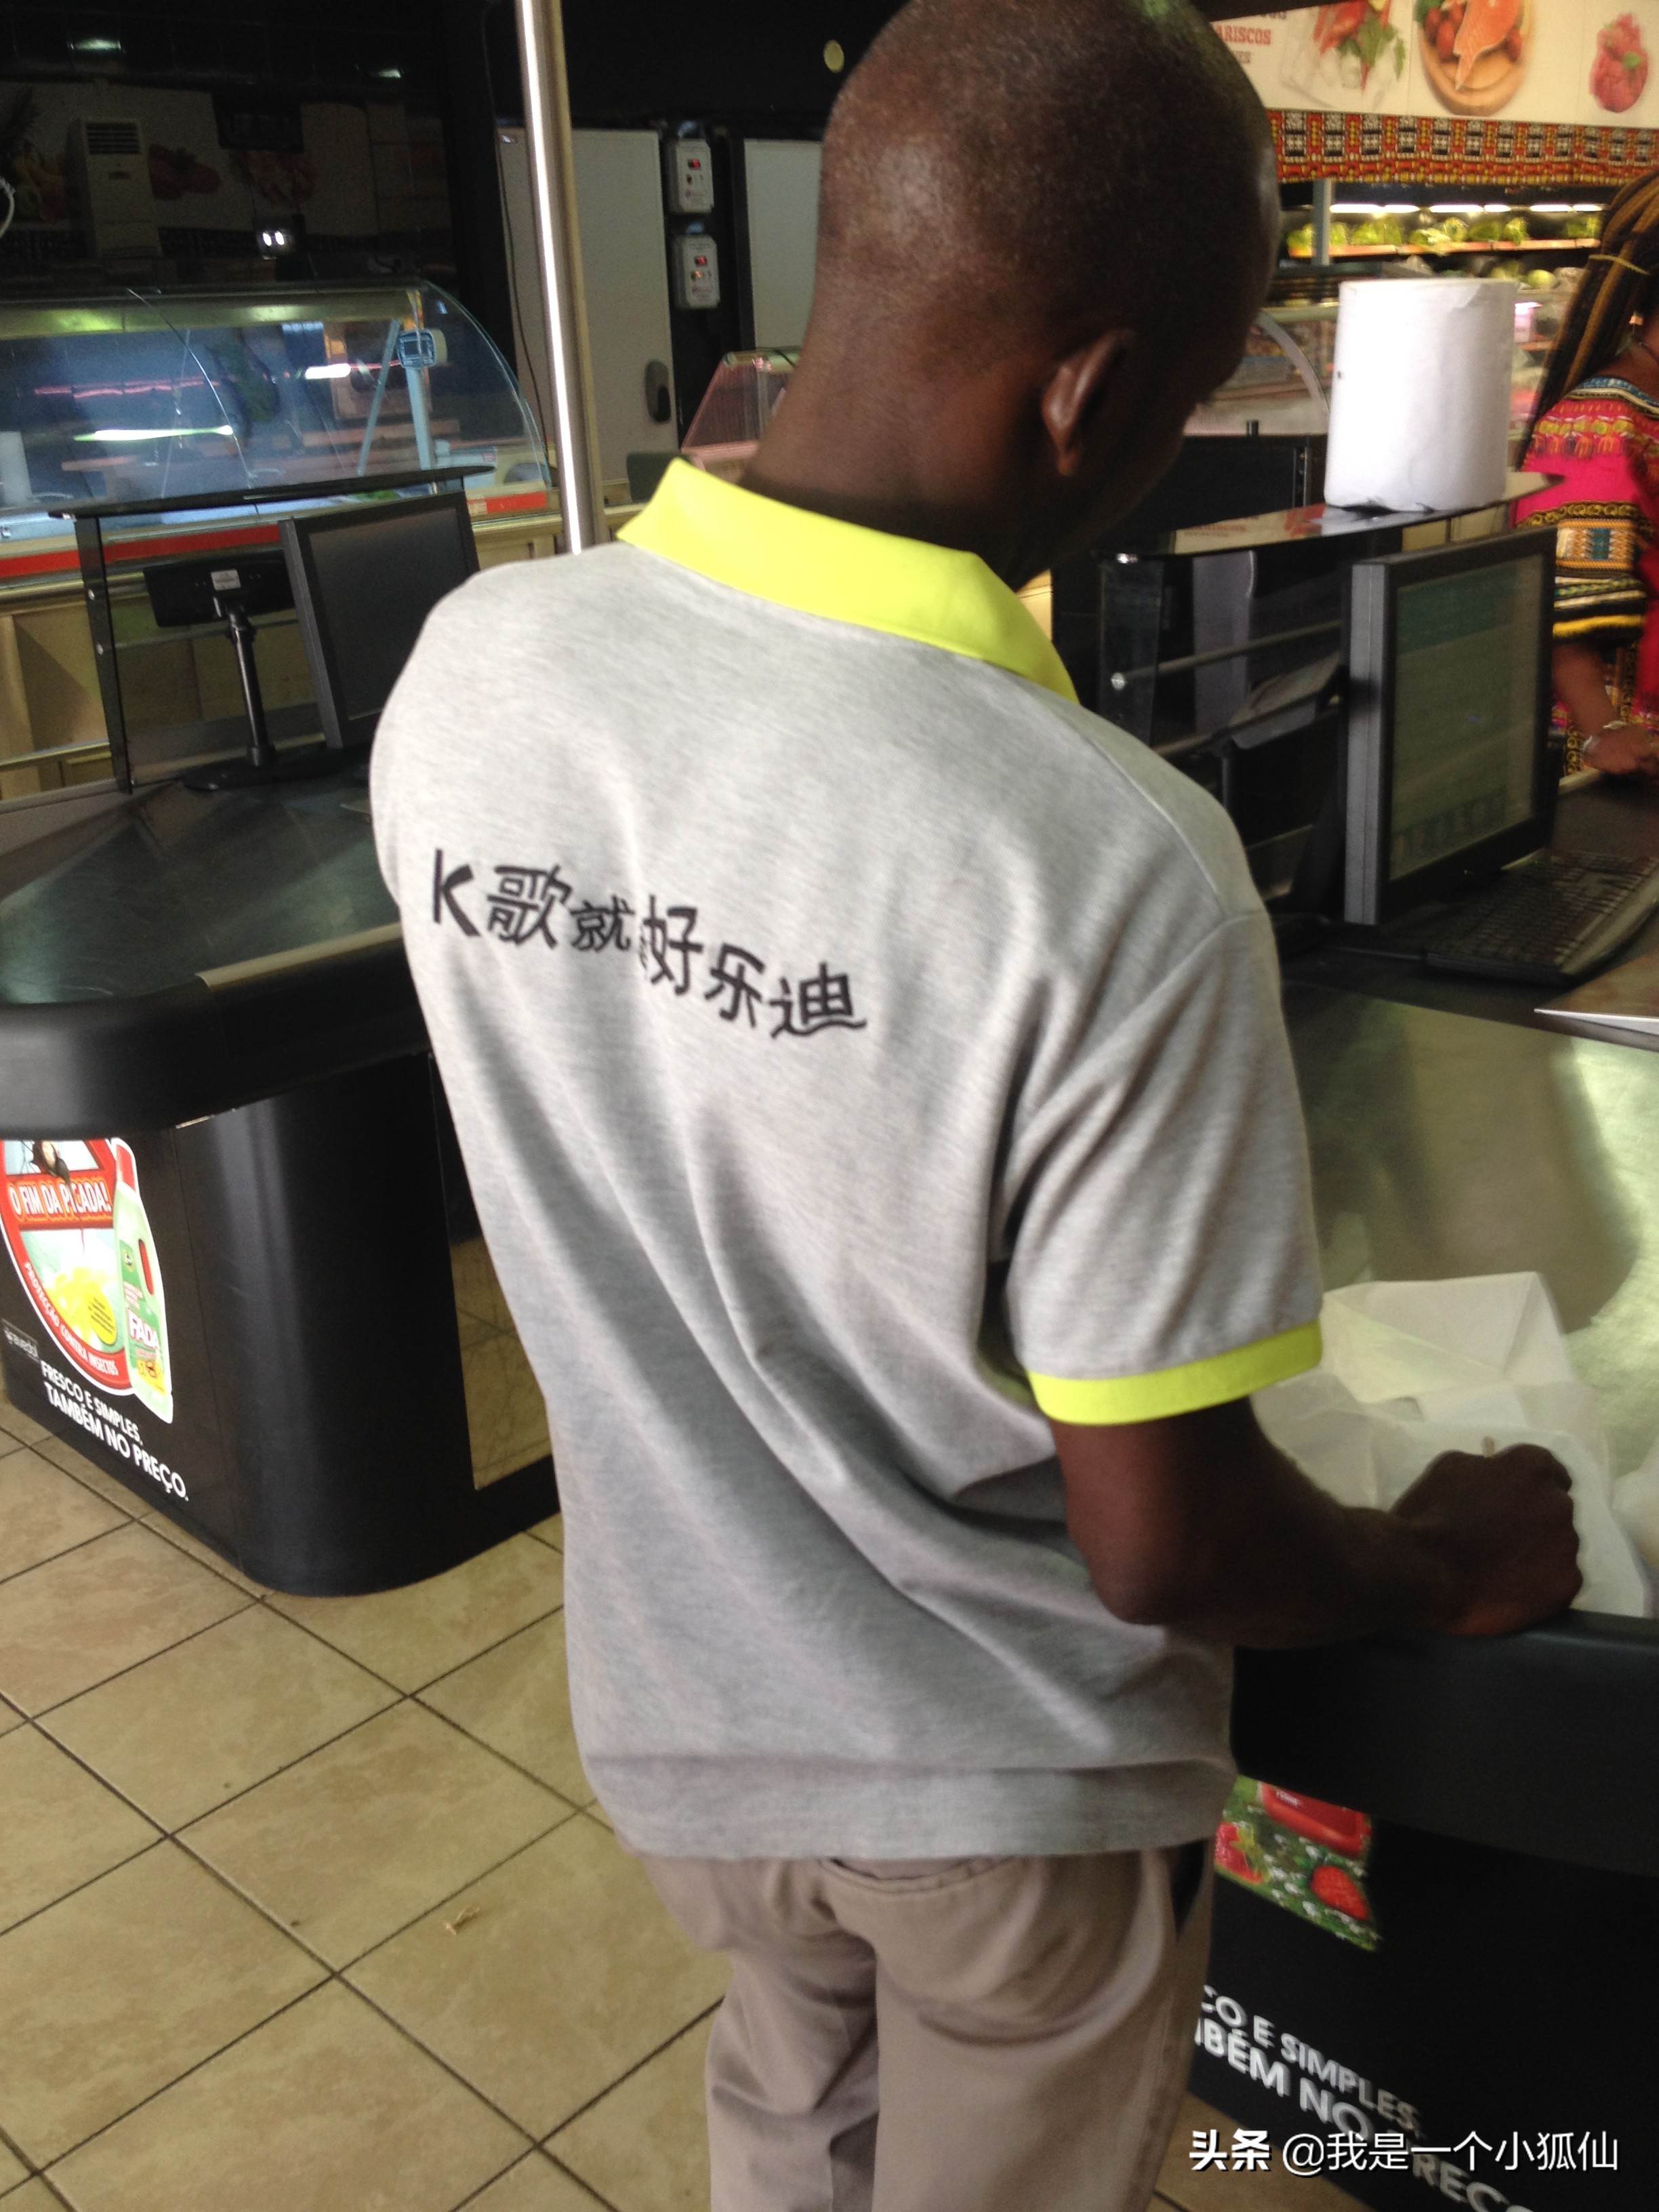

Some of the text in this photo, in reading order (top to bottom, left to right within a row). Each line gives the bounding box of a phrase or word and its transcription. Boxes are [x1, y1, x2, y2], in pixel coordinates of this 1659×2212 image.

[432, 848, 867, 1038] K歌就好乐迪
[9, 1185, 22, 1215] O
[19, 1185, 45, 1214] FIM
[41, 1183, 64, 1214] DA
[60, 1324, 89, 1362] CONTRA
[87, 1352, 119, 1376] INSECTOS
[127, 1307, 161, 1349] FADA
[41, 1359, 143, 1446] FRESCO E SIMPLES.
[43, 1380, 189, 1502] TAMBÉM NO PREÇO.
[1254, 2015, 1275, 2049] E
